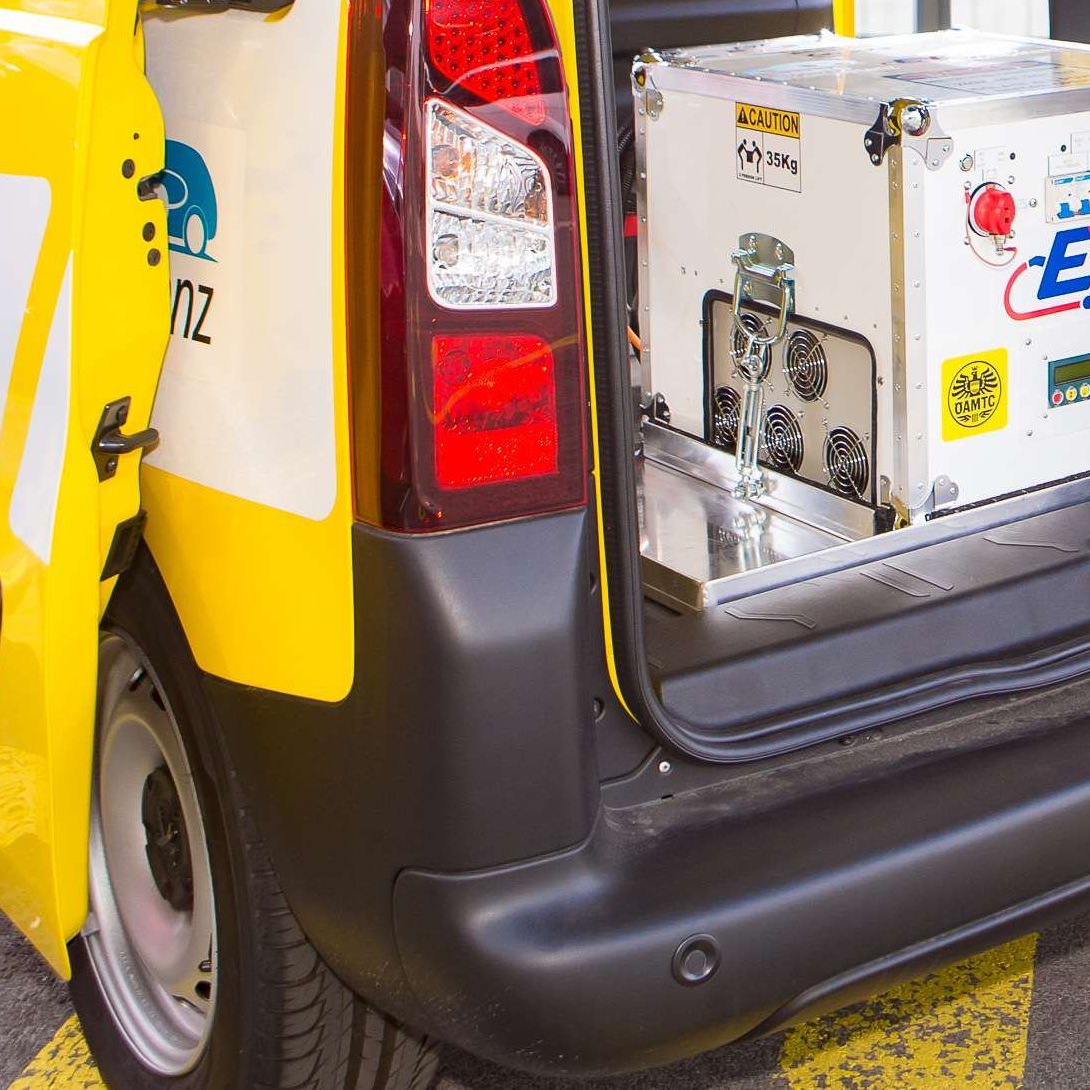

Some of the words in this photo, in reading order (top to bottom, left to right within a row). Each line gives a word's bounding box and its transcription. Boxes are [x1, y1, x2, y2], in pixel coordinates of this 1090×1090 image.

[749, 108, 799, 134] CAUTION
[766, 150, 798, 175] 35Kg
[169, 278, 214, 344] nz
